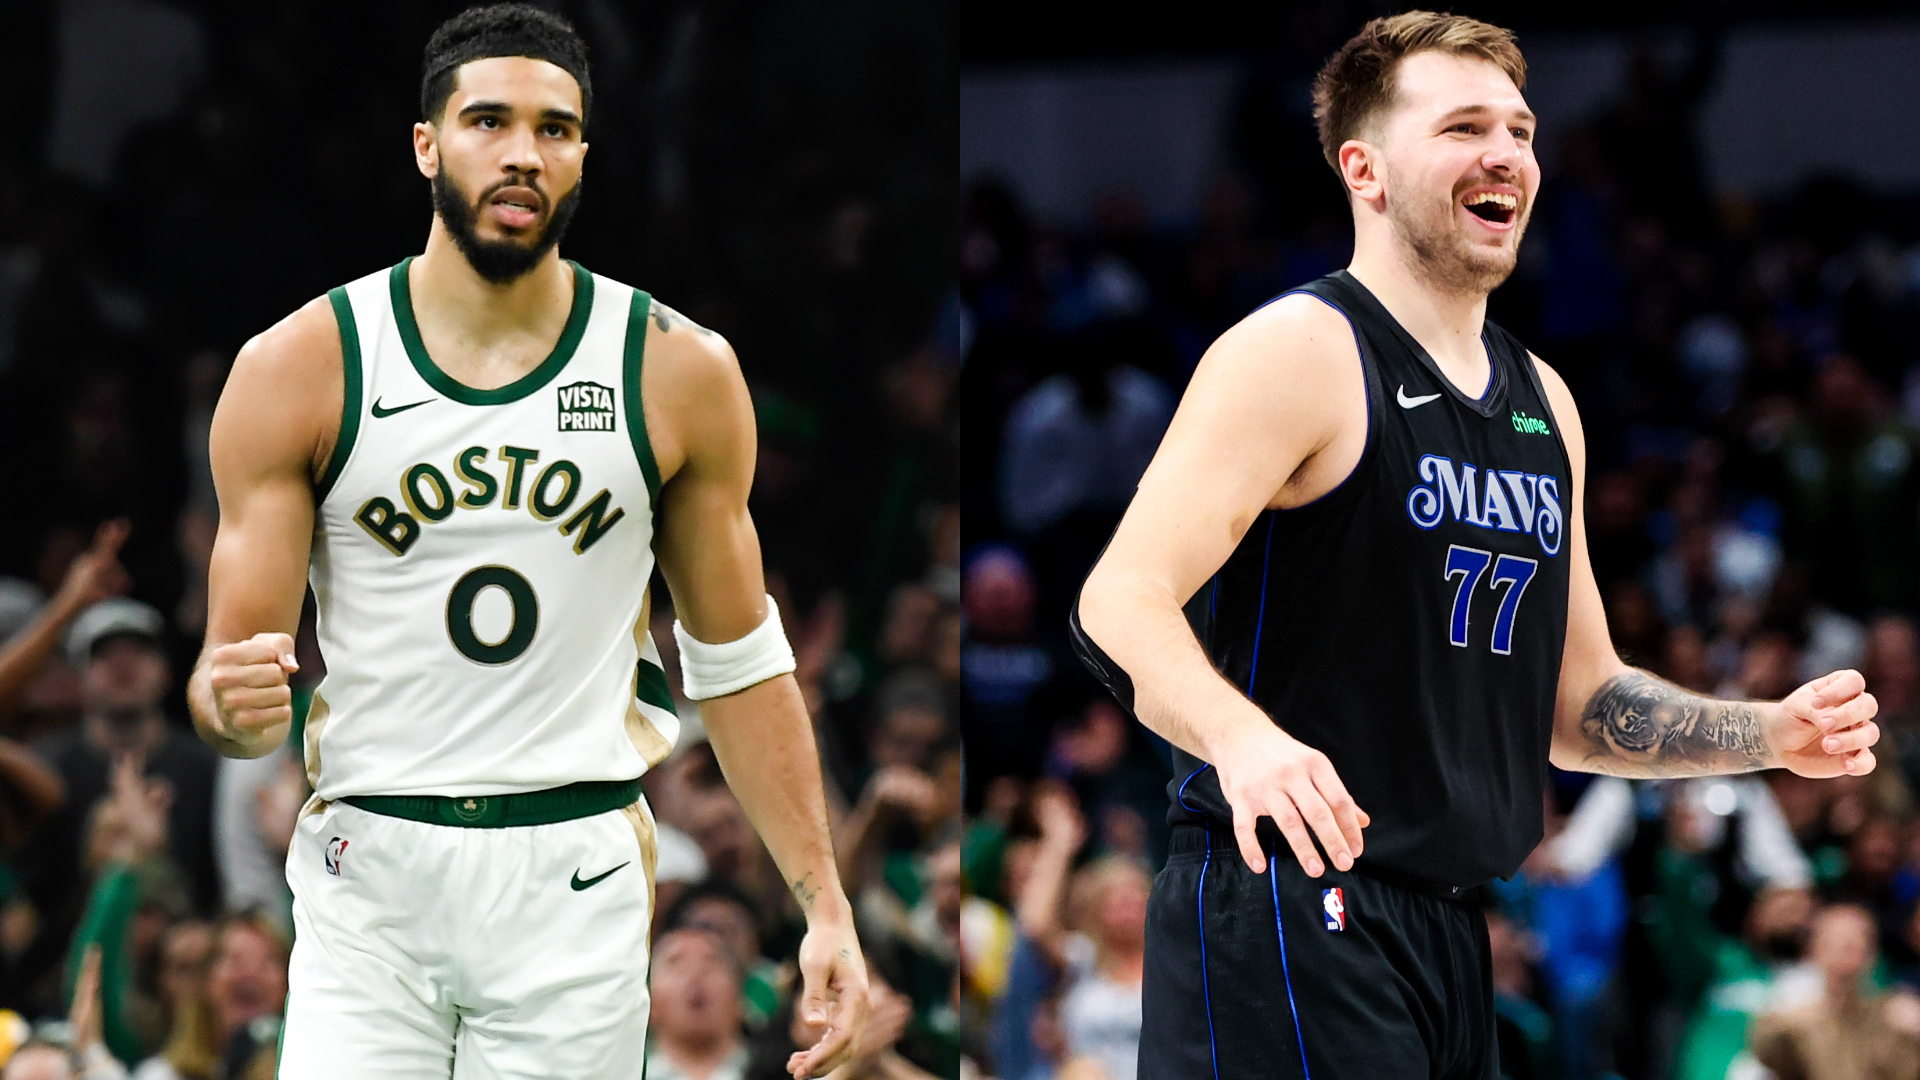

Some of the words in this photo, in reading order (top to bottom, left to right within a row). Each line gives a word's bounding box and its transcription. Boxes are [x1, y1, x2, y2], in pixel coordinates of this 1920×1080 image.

[559, 385, 614, 411] VISTA
[560, 411, 614, 430] PRINT
[1512, 411, 1550, 435] chime
[354, 445, 625, 556] BOSTON
[1406, 454, 1563, 557] MAVS
[1444, 544, 1539, 655] 77
